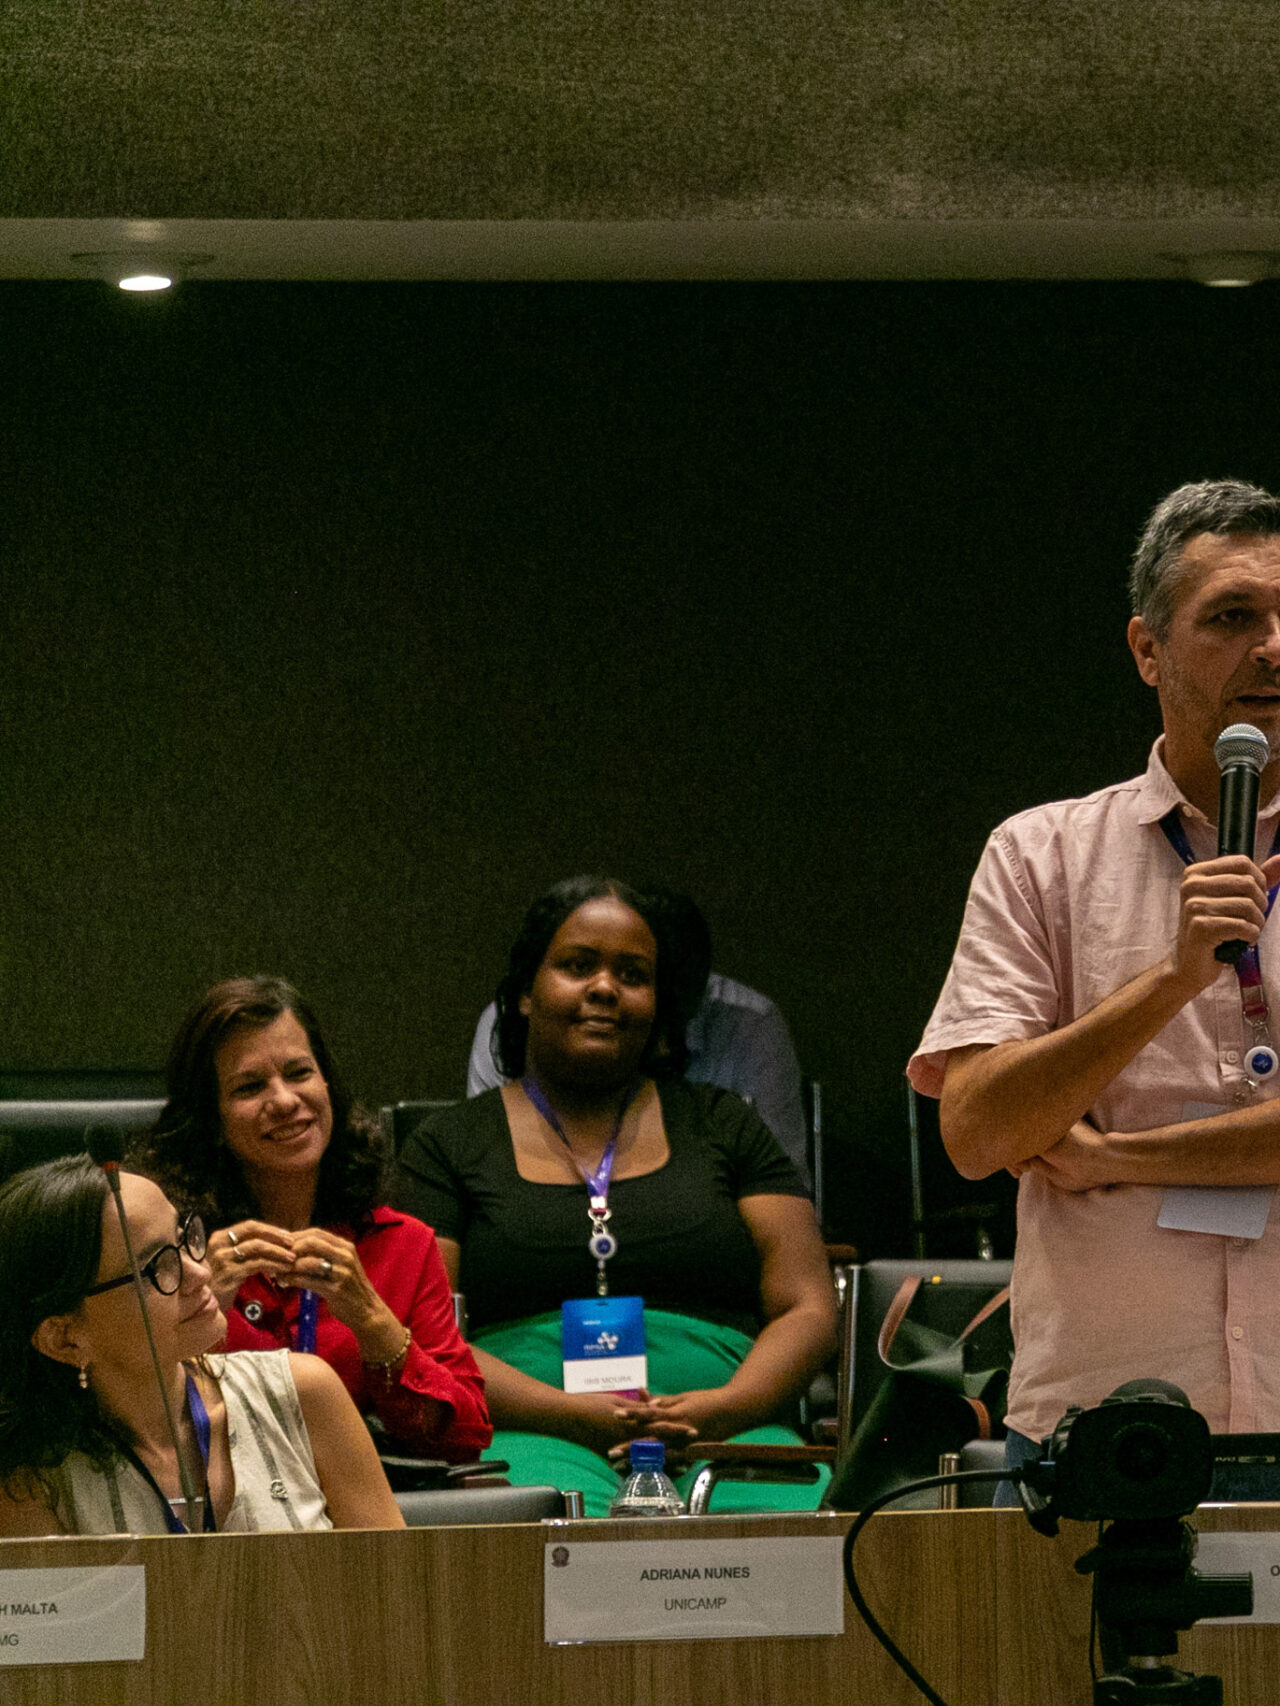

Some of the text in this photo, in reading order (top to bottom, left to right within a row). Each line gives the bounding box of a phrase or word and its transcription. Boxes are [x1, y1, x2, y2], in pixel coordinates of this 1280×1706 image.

[640, 1566, 750, 1581] ADRIANA NUNES
[11, 1602, 58, 1615] MALTA
[664, 1597, 727, 1611] UNICAMP
